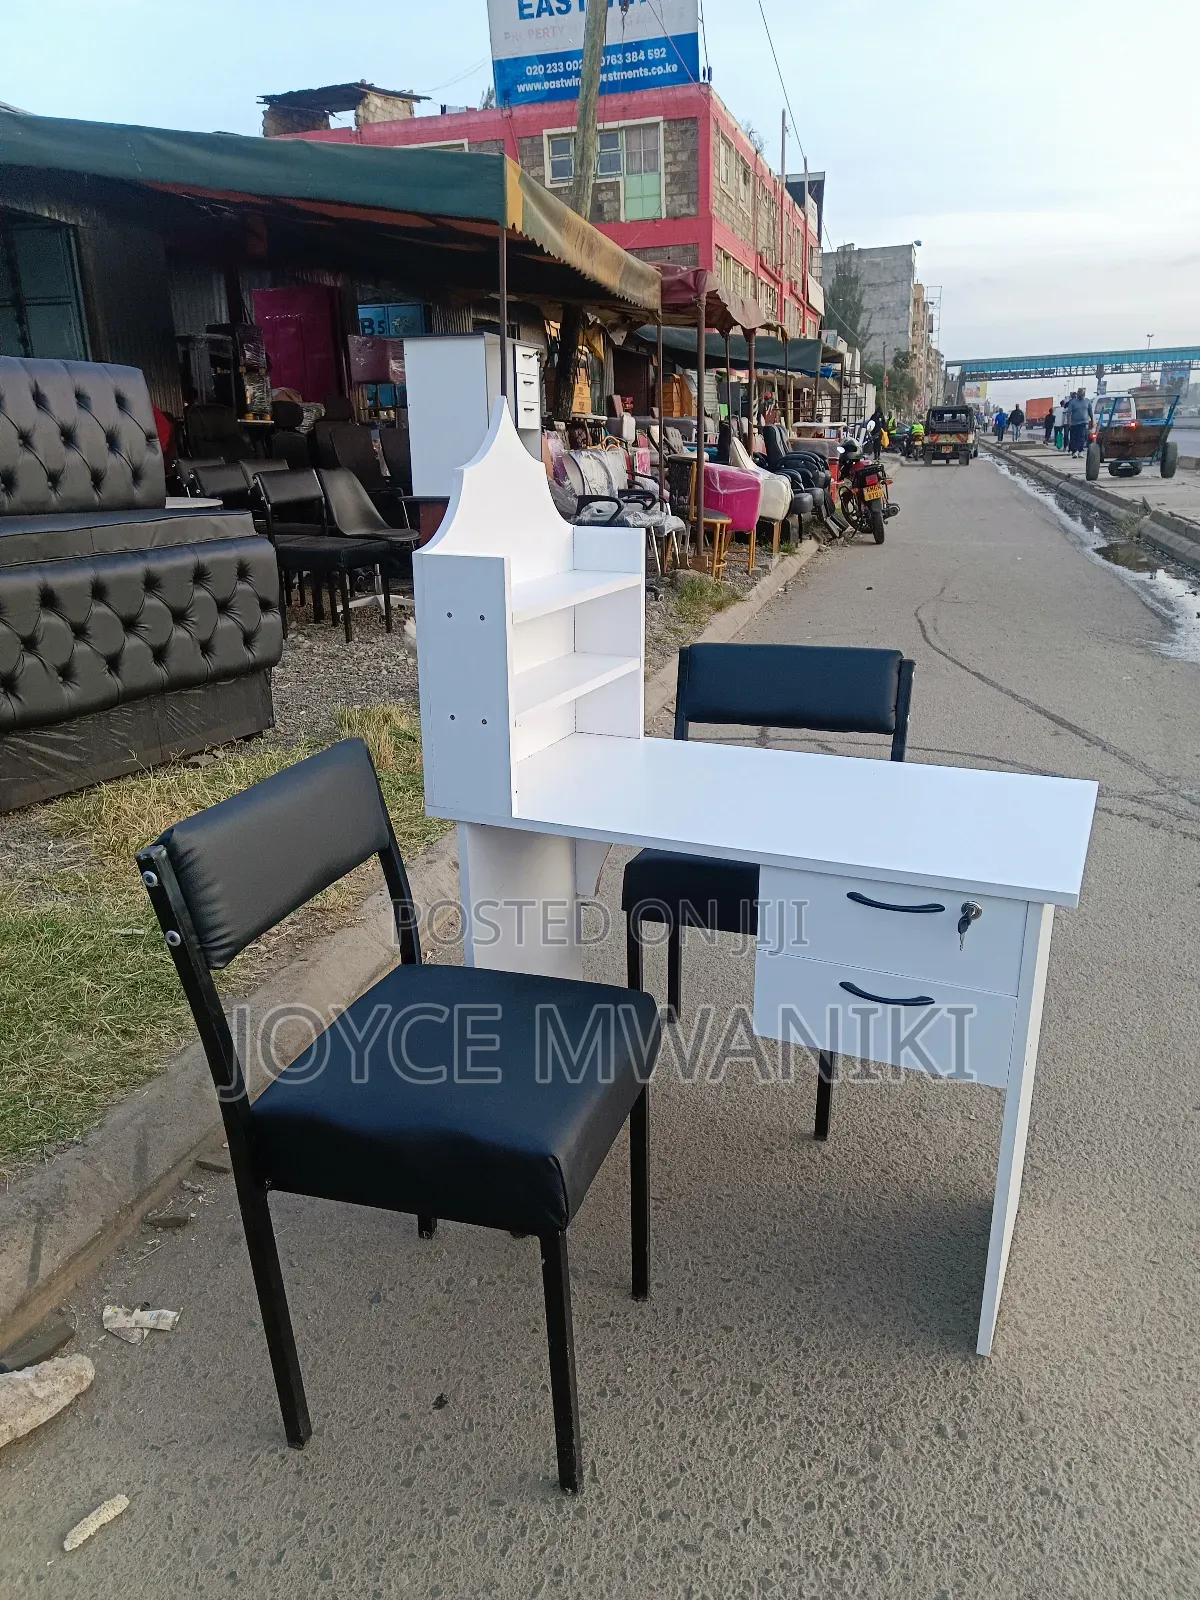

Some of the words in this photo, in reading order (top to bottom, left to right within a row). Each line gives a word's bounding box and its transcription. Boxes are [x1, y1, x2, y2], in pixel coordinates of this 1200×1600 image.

[526, 64, 544, 75] 020
[546, 62, 563, 73] 233
[601, 54, 623, 66] 0763
[625, 50, 645, 63] 384
[648, 47, 666, 59] 592
